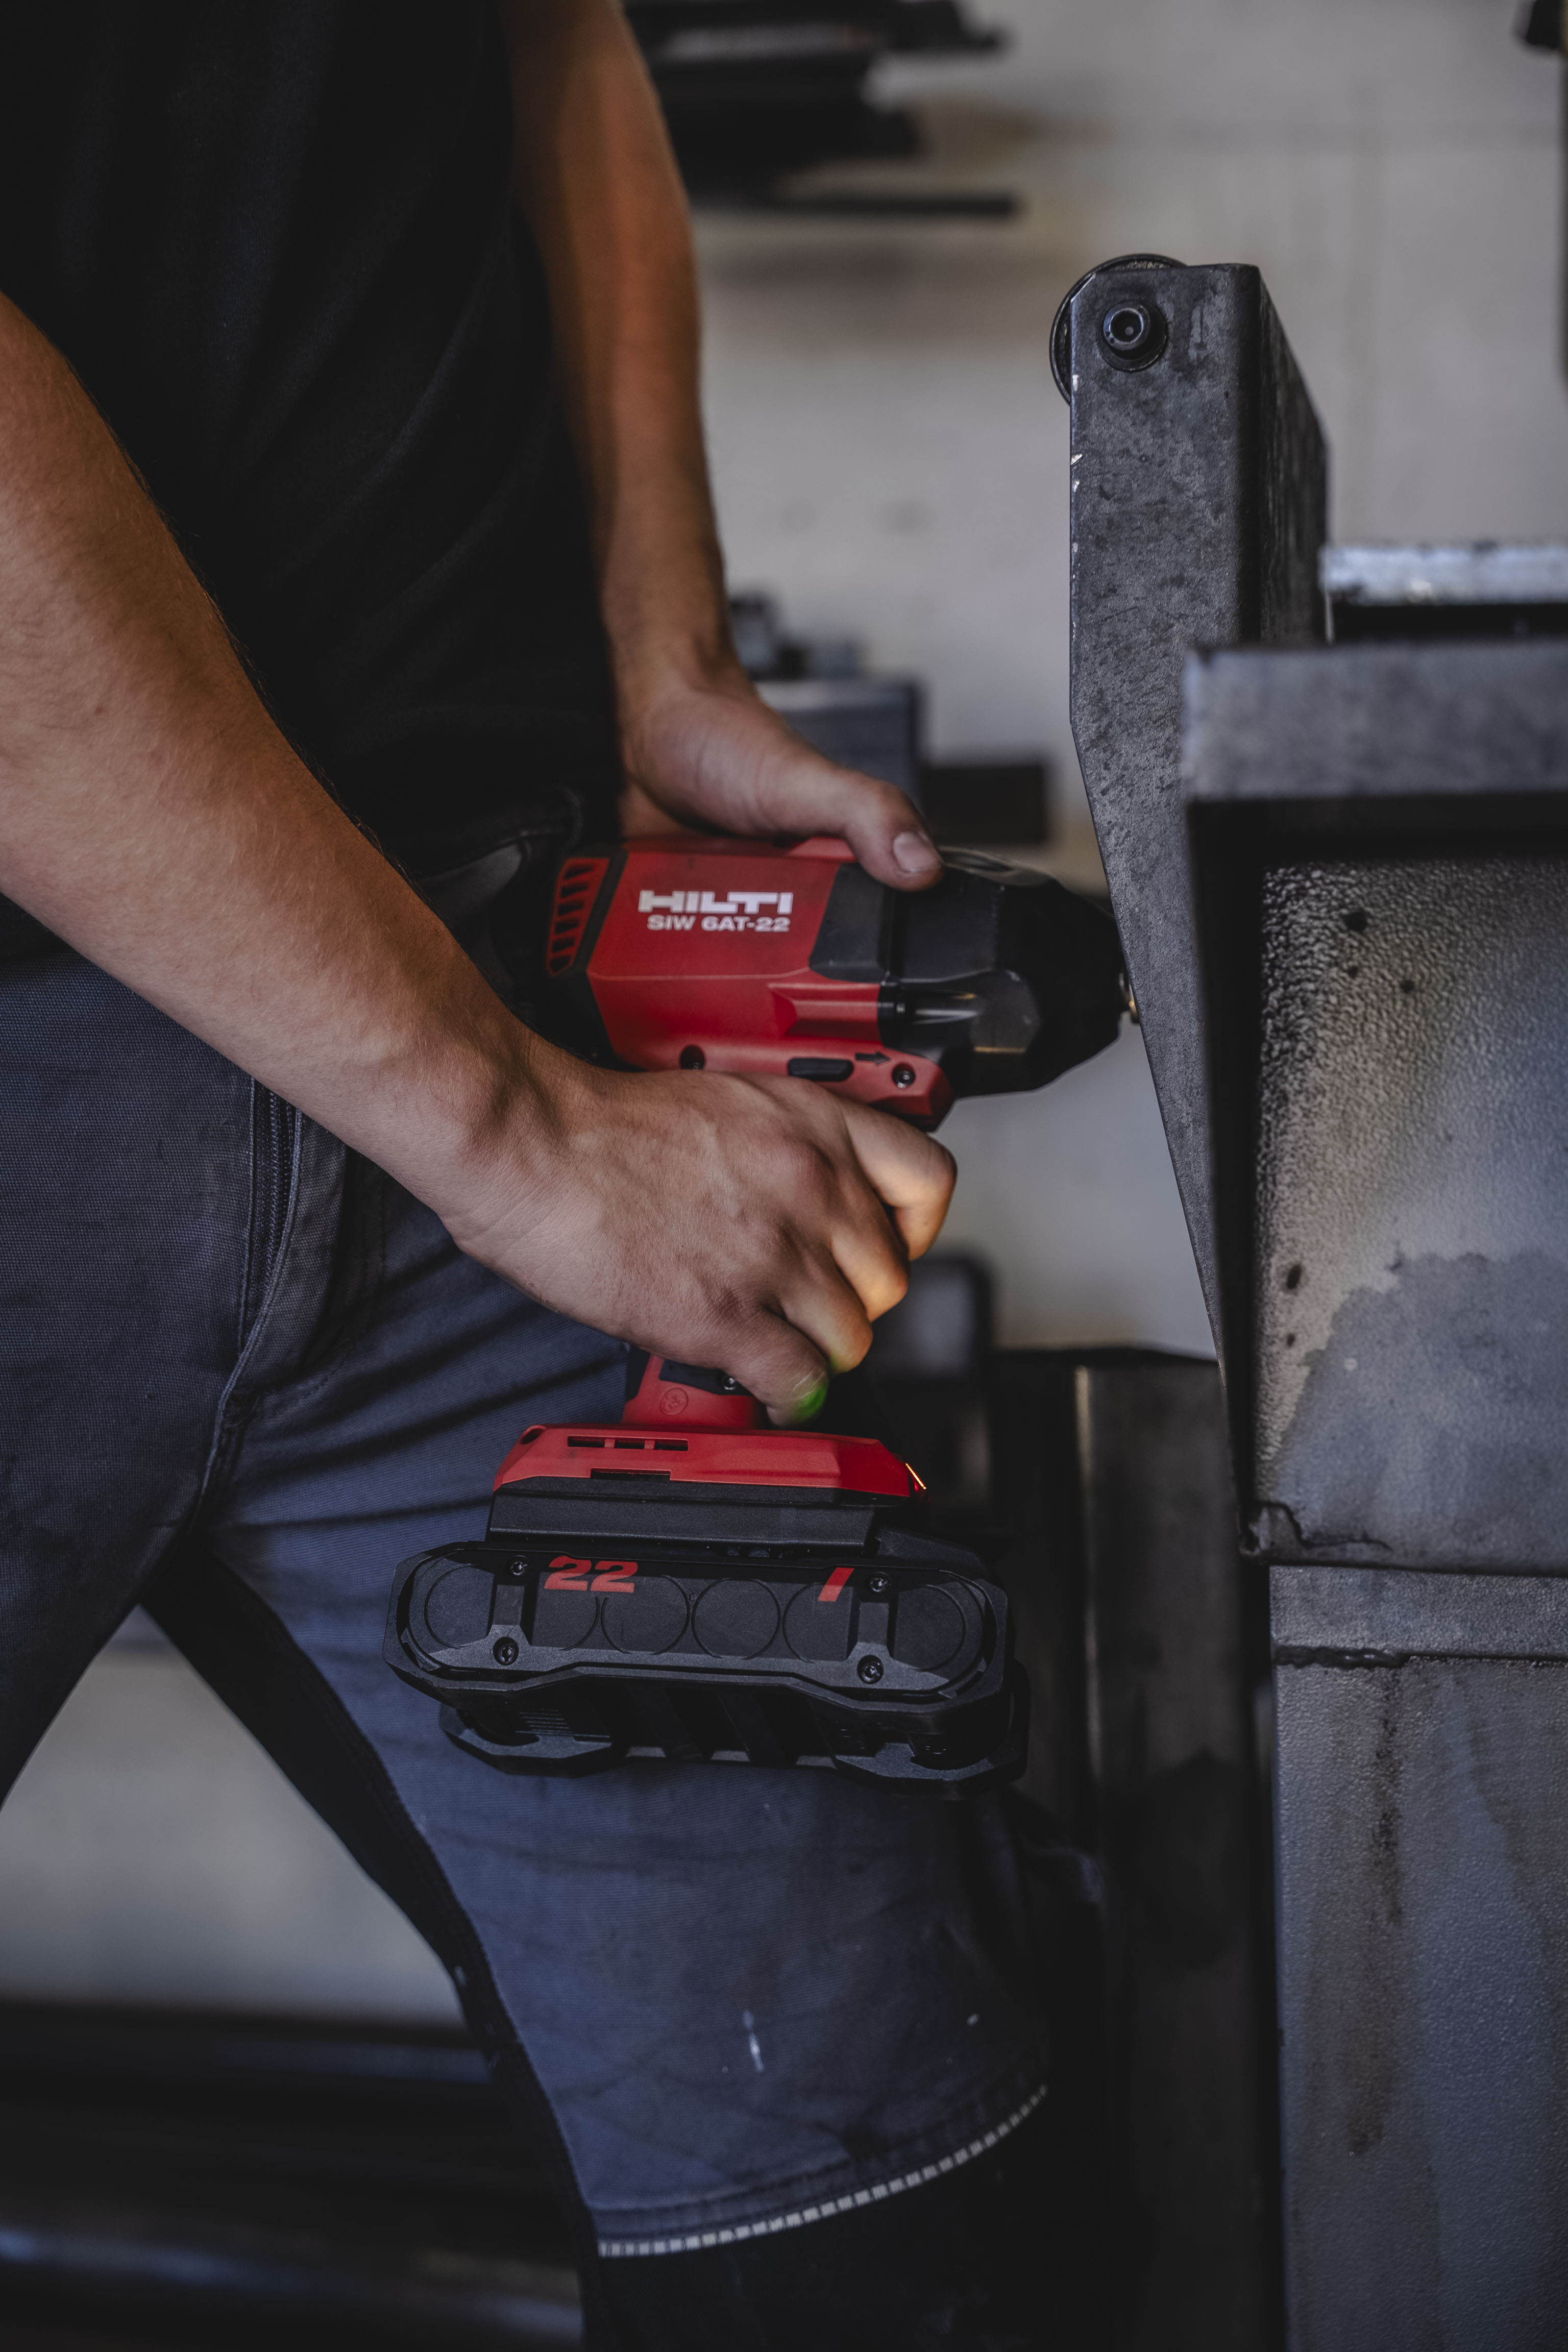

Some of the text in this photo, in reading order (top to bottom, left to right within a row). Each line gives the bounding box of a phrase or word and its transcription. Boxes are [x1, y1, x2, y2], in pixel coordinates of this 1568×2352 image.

[638, 890, 794, 915] HILTI
[647, 915, 791, 932] SIW 6AT-22
[544, 1555, 639, 1593] 22
